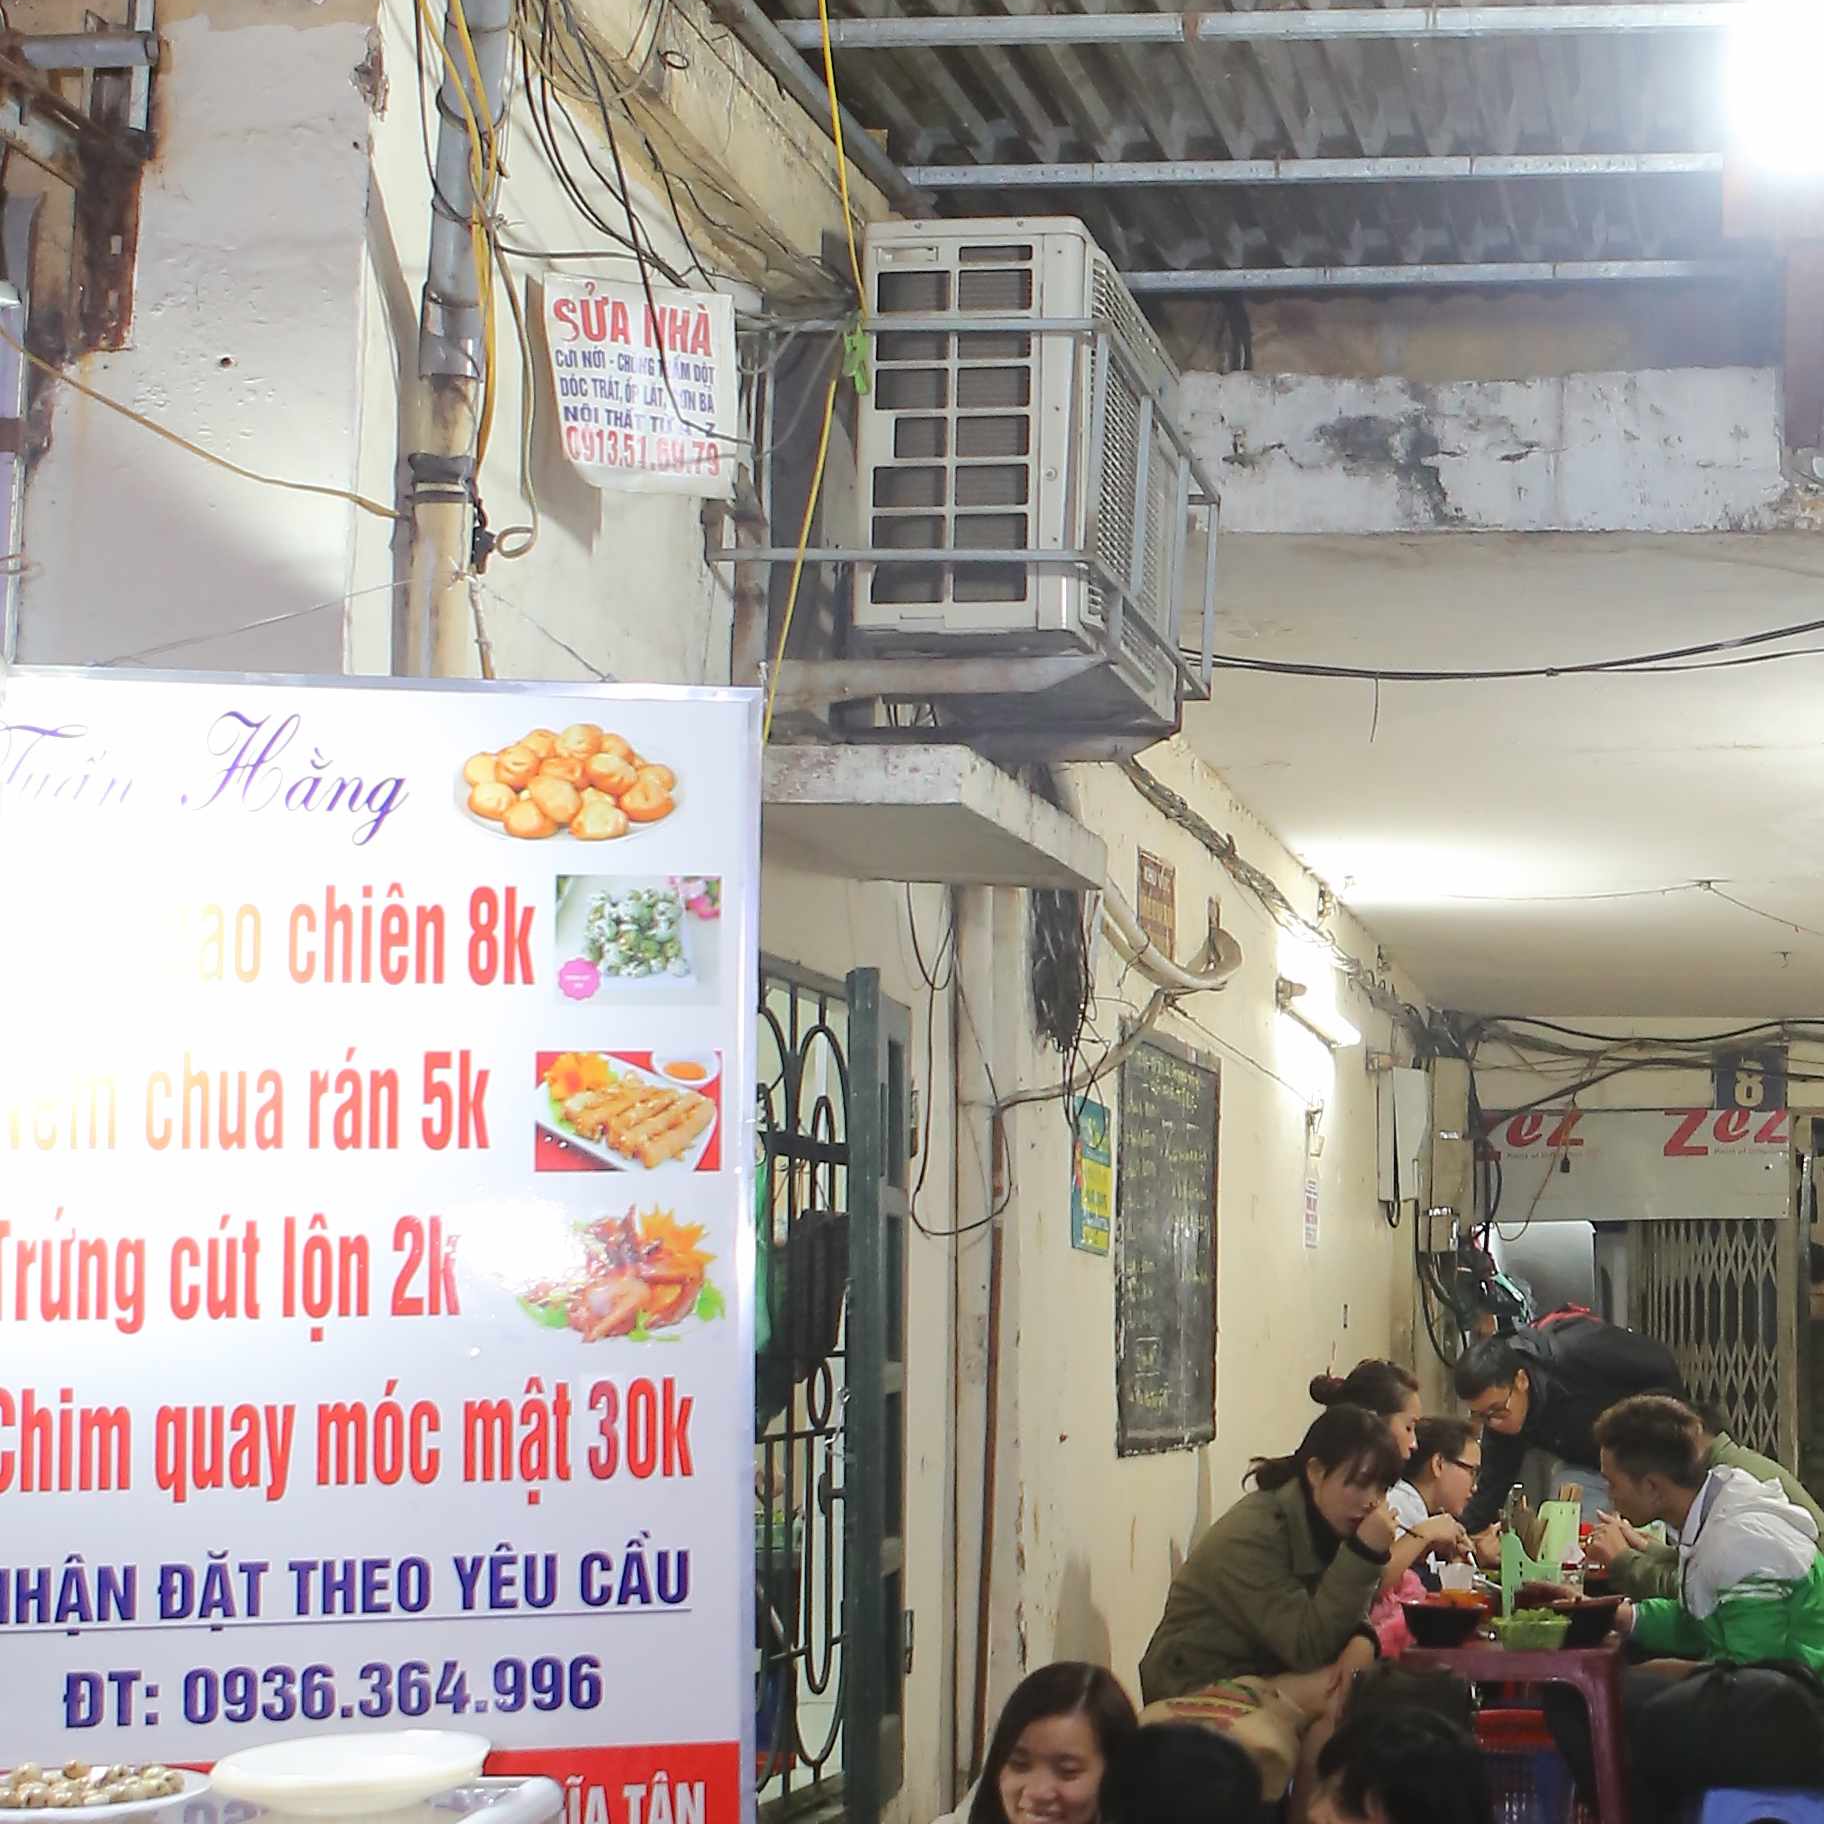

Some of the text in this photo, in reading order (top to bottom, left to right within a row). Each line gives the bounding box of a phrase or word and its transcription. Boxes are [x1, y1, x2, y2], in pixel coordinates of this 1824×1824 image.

[553, 281, 713, 358] SỬA NHÀ
[181, 710, 411, 847] Hằng
[287, 881, 446, 987] chiên
[467, 885, 536, 987] 8k
[144, 1050, 284, 1152] chua
[308, 1046, 401, 1152] rán
[421, 1049, 491, 1153] 5k
[169, 1213, 261, 1321] cút
[282, 1212, 371, 1343] lộn
[389, 1214, 462, 1317] 2k
[154, 1402, 297, 1505] quay
[315, 1378, 441, 1486] móc
[463, 1375, 571, 1507] mật
[587, 1375, 695, 1482] 30k
[0, 1529, 691, 1637] HẬN ĐẶT THEO YÊU CẦU
[63, 1653, 604, 1732] ĐT: 0936.364.996
